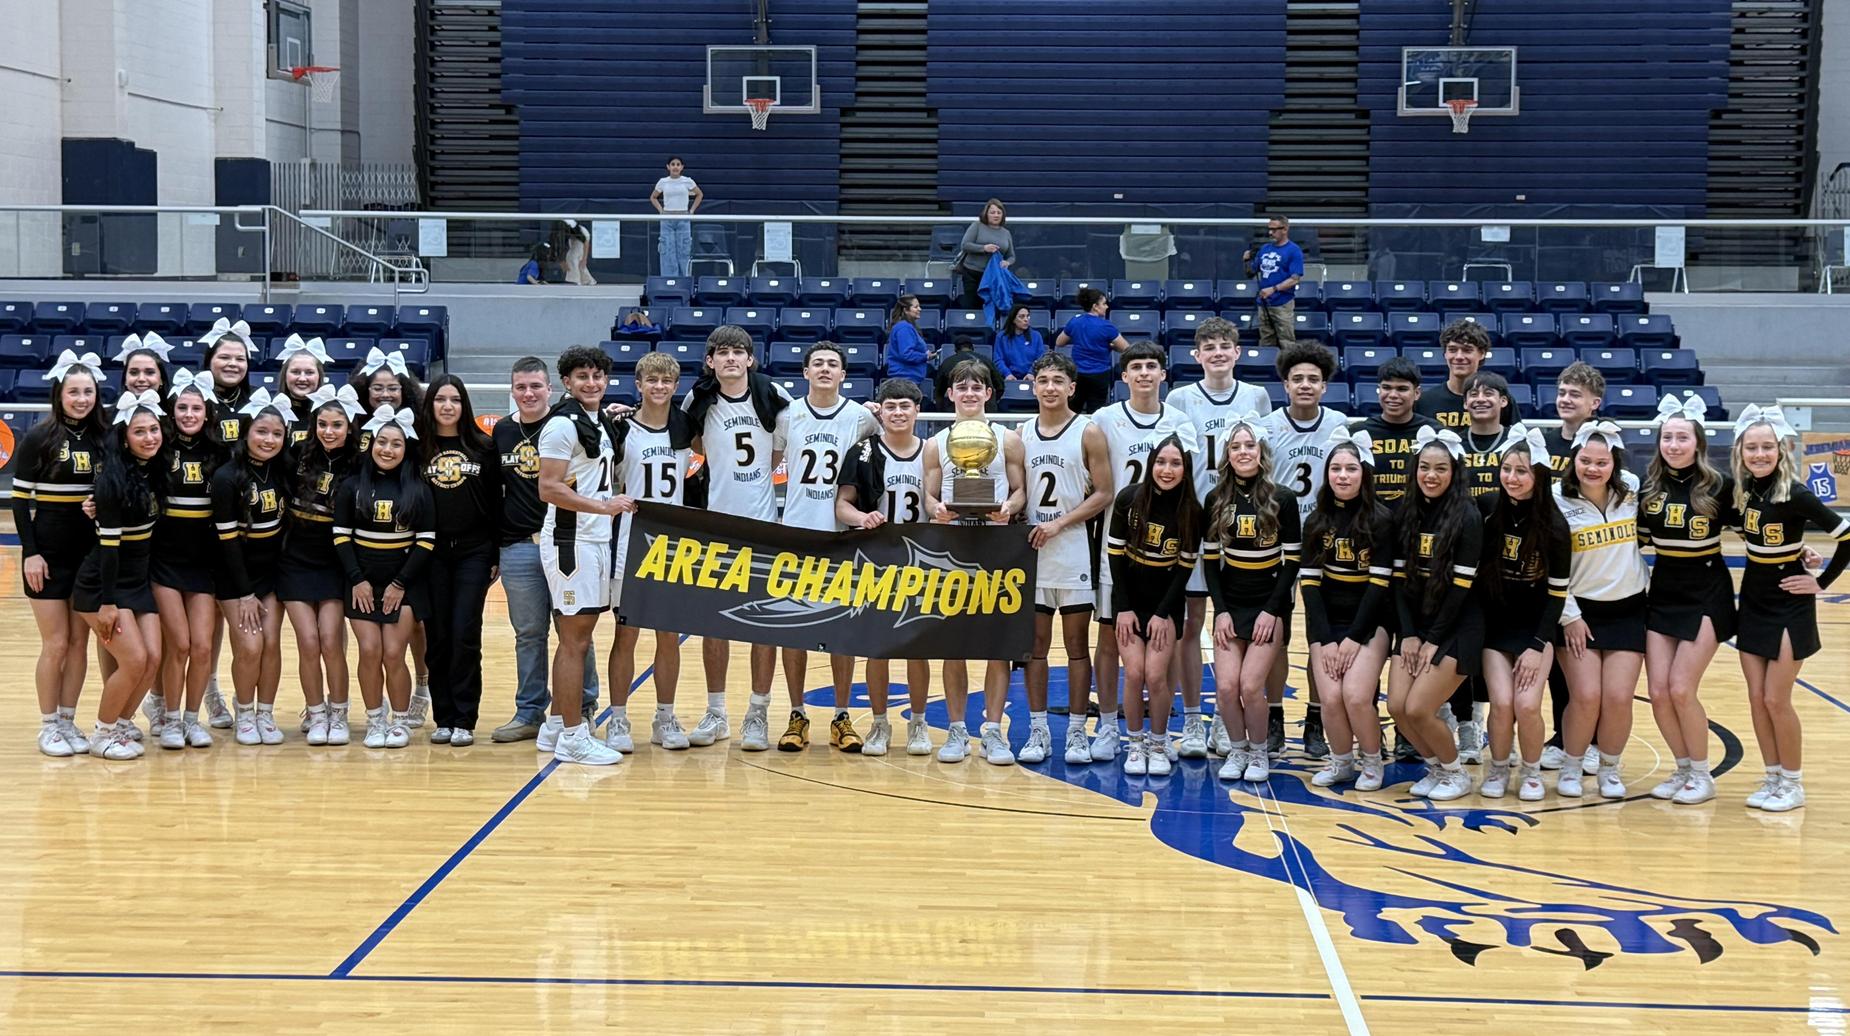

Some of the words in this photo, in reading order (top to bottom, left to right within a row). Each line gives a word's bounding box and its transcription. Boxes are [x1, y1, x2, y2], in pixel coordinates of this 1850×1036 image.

[724, 415, 760, 431] SEMINOLE
[1436, 411, 1472, 427] SOA
[805, 432, 839, 447] SEMINOLE
[735, 432, 755, 467] 5
[1128, 440, 1154, 456] SEMIN
[1205, 435, 1217, 470] 1
[1288, 445, 1324, 460] SEMINOLE
[501, 454, 520, 465] PLAY
[800, 449, 838, 485] 23
[1031, 454, 1065, 469] SEMINOLE
[1389, 459, 1405, 470] TO
[1464, 452, 1499, 468] SOA
[640, 462, 677, 499] 15
[733, 468, 761, 483] INDIANS
[887, 473, 922, 490] SEMINOLE
[1295, 462, 1312, 497] 3
[1373, 473, 1407, 484] TRIUM
[1477, 472, 1493, 483] TO
[805, 487, 834, 501] INDIANS
[1039, 471, 1058, 507] 2
[1812, 477, 1831, 497] 15
[887, 490, 920, 523] 13
[1578, 523, 1636, 546] SEMINOLE
[635, 533, 752, 593] AREA
[766, 551, 1026, 617] CHAMPIONS
